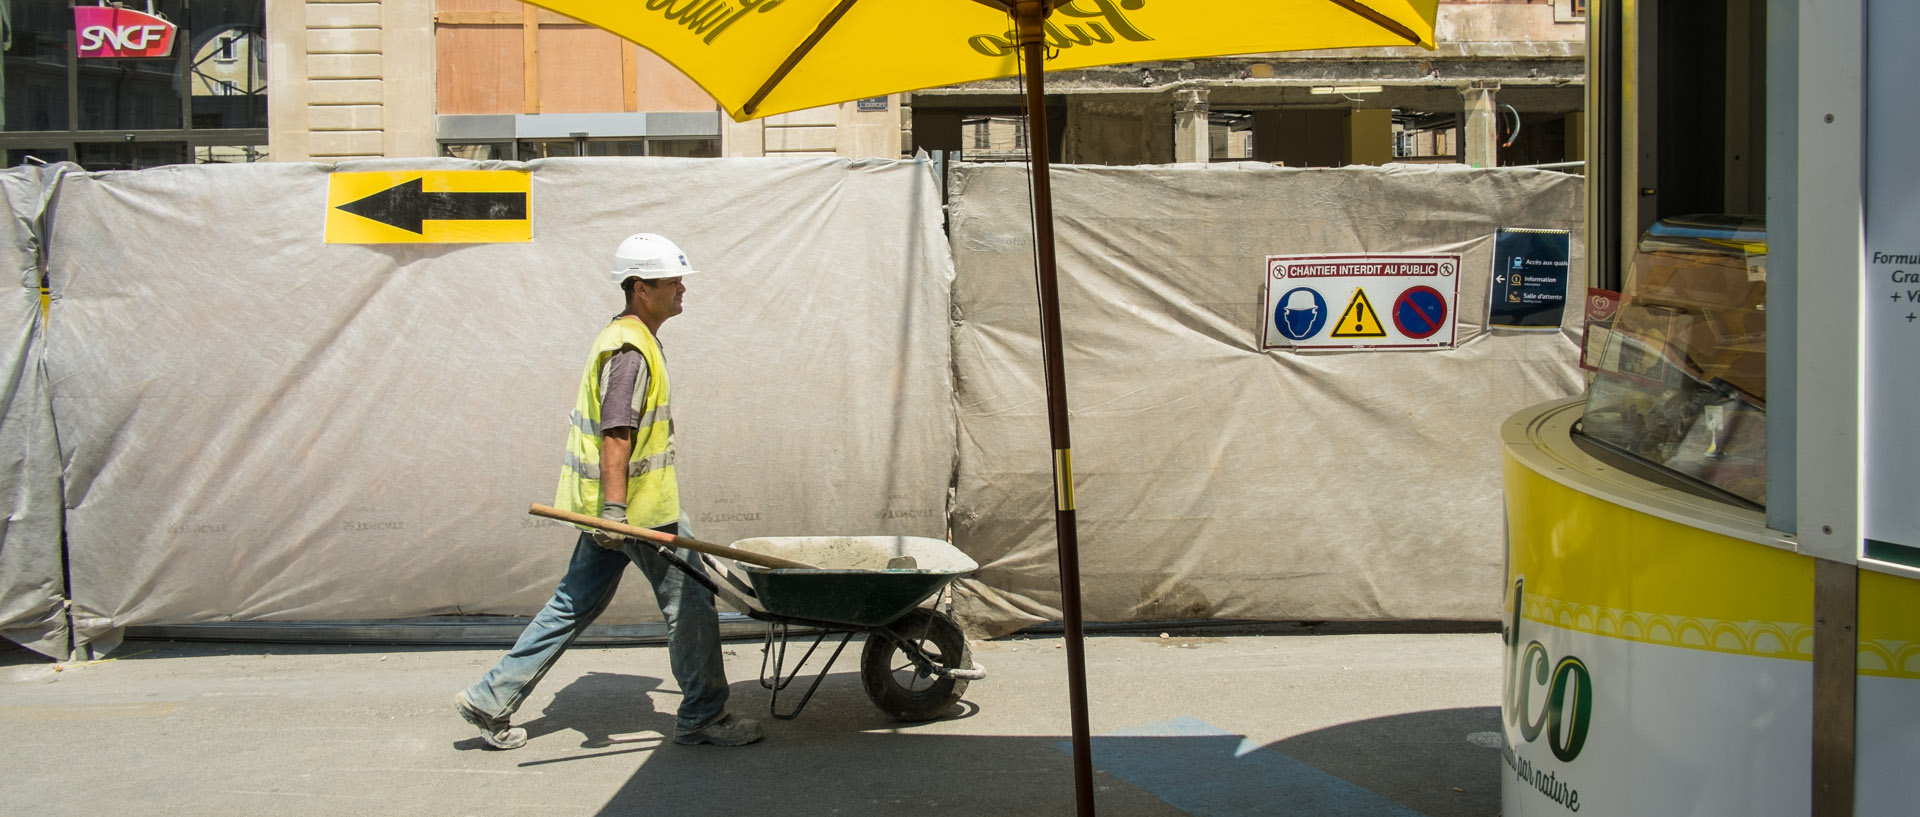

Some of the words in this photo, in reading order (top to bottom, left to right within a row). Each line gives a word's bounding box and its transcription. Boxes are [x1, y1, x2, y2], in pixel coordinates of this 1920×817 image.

[80, 25, 166, 51] SNCF
[1290, 265, 1337, 277] CHANTIER
[1339, 264, 1382, 275] INTERDIT
[1384, 264, 1398, 275] AU
[1400, 264, 1436, 275] PUBLIC
[1517, 756, 1535, 787] par
[1535, 770, 1581, 813] nature
